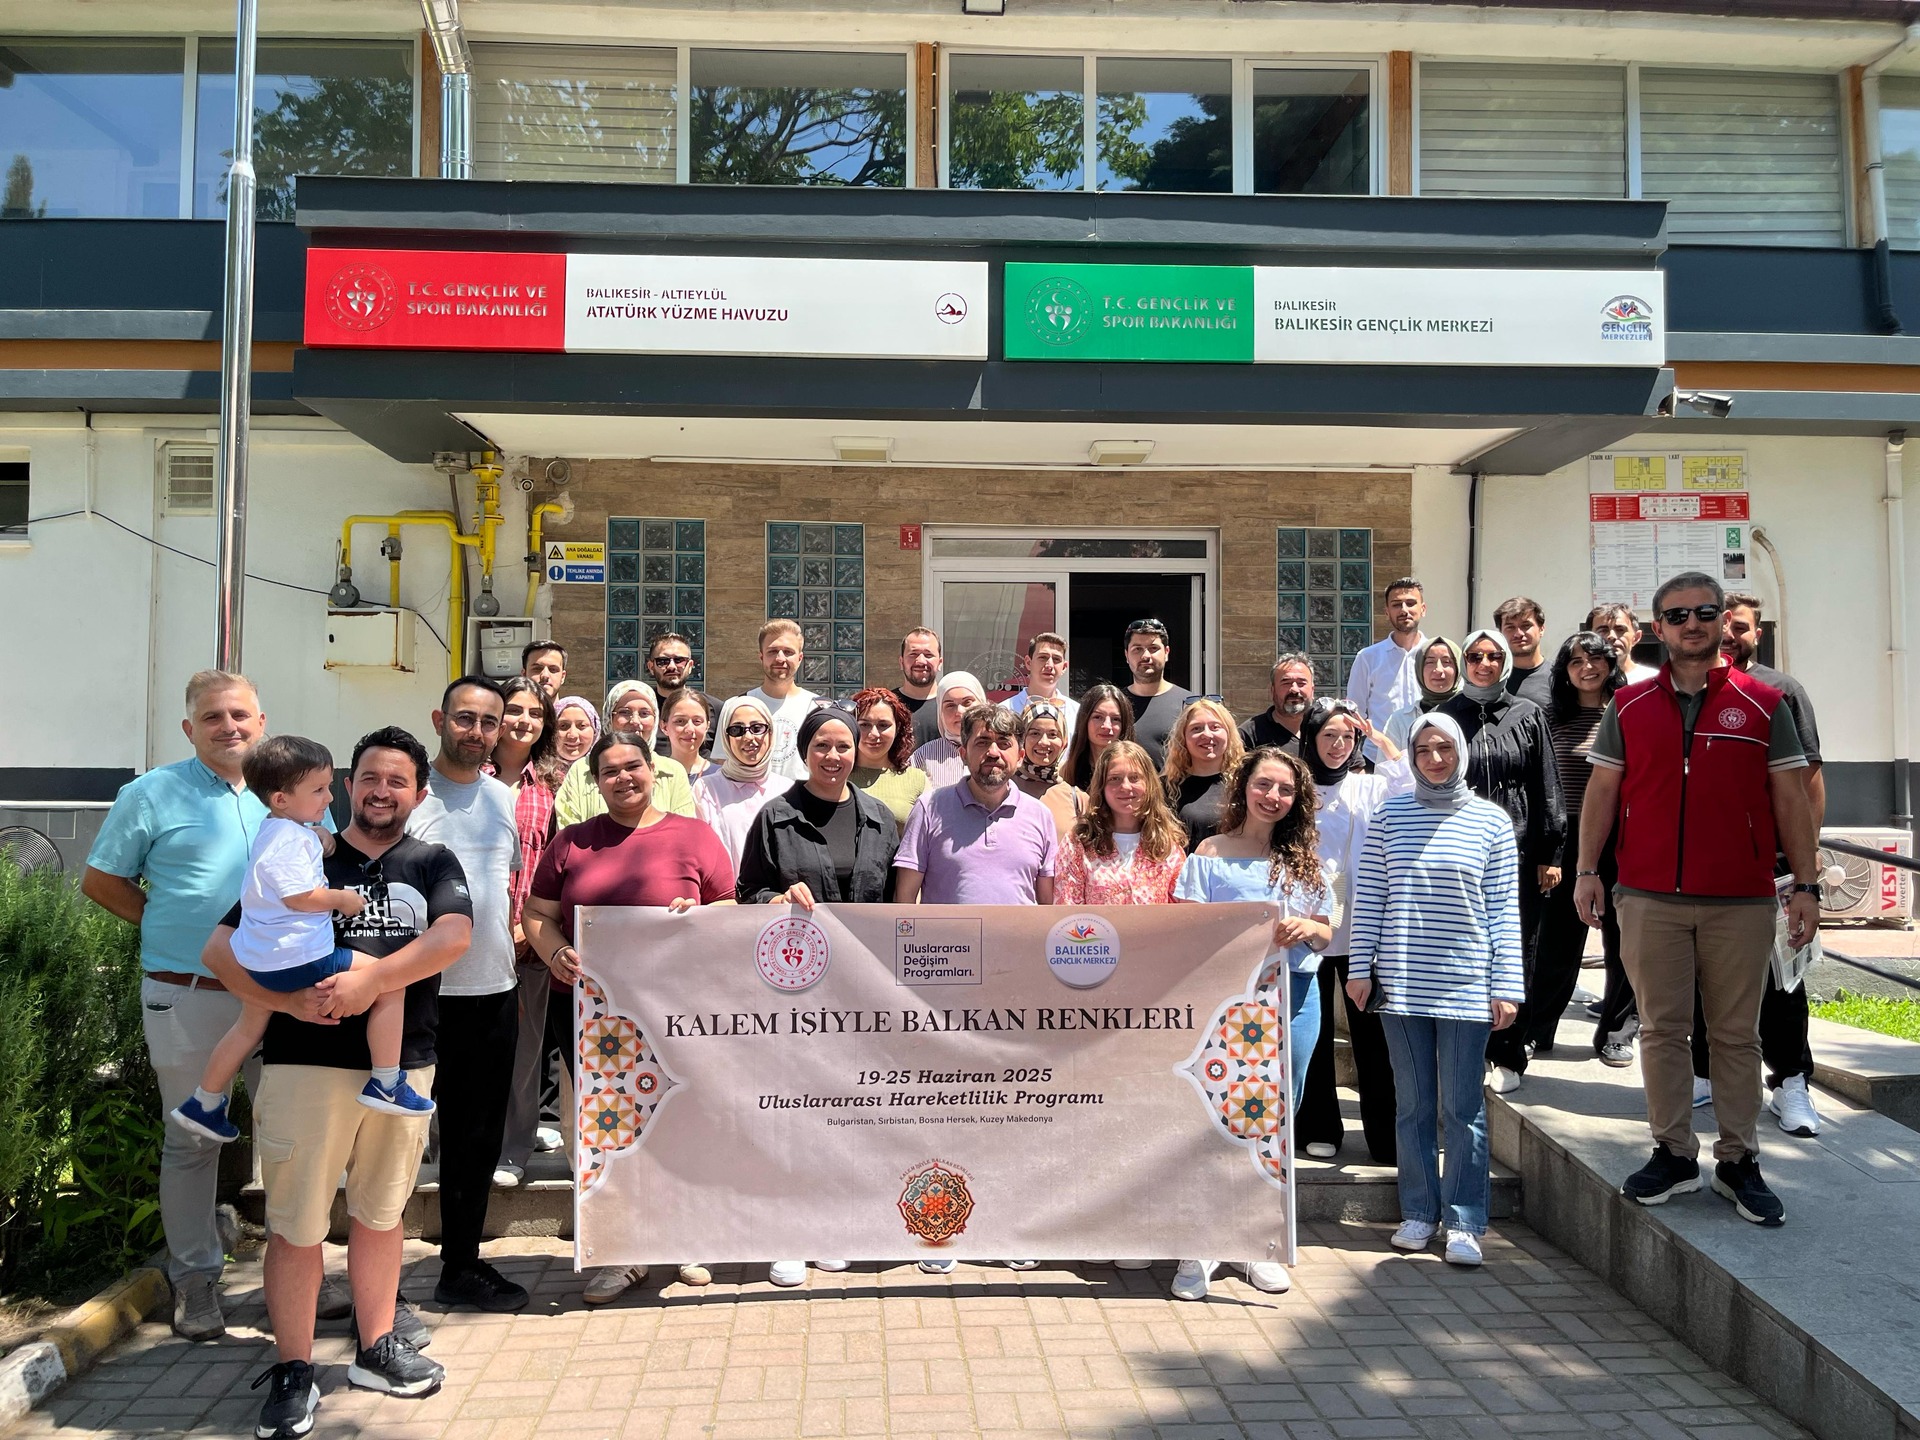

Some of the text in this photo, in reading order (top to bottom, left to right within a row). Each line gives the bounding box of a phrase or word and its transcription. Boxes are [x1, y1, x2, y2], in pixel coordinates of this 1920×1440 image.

[408, 282, 548, 300] T.C. GENÇLİK VE
[586, 286, 651, 299] BALIKESİR
[661, 288, 728, 301] ALTIEYLÜL
[406, 301, 548, 317] SPOR BAKANLIĞI
[1102, 295, 1237, 312] T.C. GENÇLİK VE
[1274, 298, 1337, 311] BALIKESİR
[586, 303, 789, 322] ATATÜRK YÜZME HAVUZU
[1102, 314, 1237, 330] SPOR BAKANLIĞI
[1274, 315, 1494, 334] BALIKESİR GENÇLİK MERKEZİ
[1601, 321, 1650, 333] GENÇLİK
[908, 531, 913, 543] 5
[1881, 842, 1898, 911] VESTL
[1898, 874, 1906, 908] inverter
[343, 929, 380, 938] ALPINE
[903, 943, 970, 953] Uluslararası
[1055, 942, 1110, 955] BALIKESİR
[903, 955, 949, 968] Değişim
[1083, 956, 1117, 965] MERKEZİ
[903, 967, 975, 980] Programları.
[664, 1003, 1195, 1038] KALEM İŞİYLE BALKAN RENKLERİ
[856, 1068, 1053, 1085] 19-25 Haziran 2025
[758, 1090, 1104, 1110] Uluslararası Hareketlilik Programı
[826, 1115, 1053, 1127] Bulgaristan, Sırbistan, Bosna Hersek, Kuzey Makedonya
